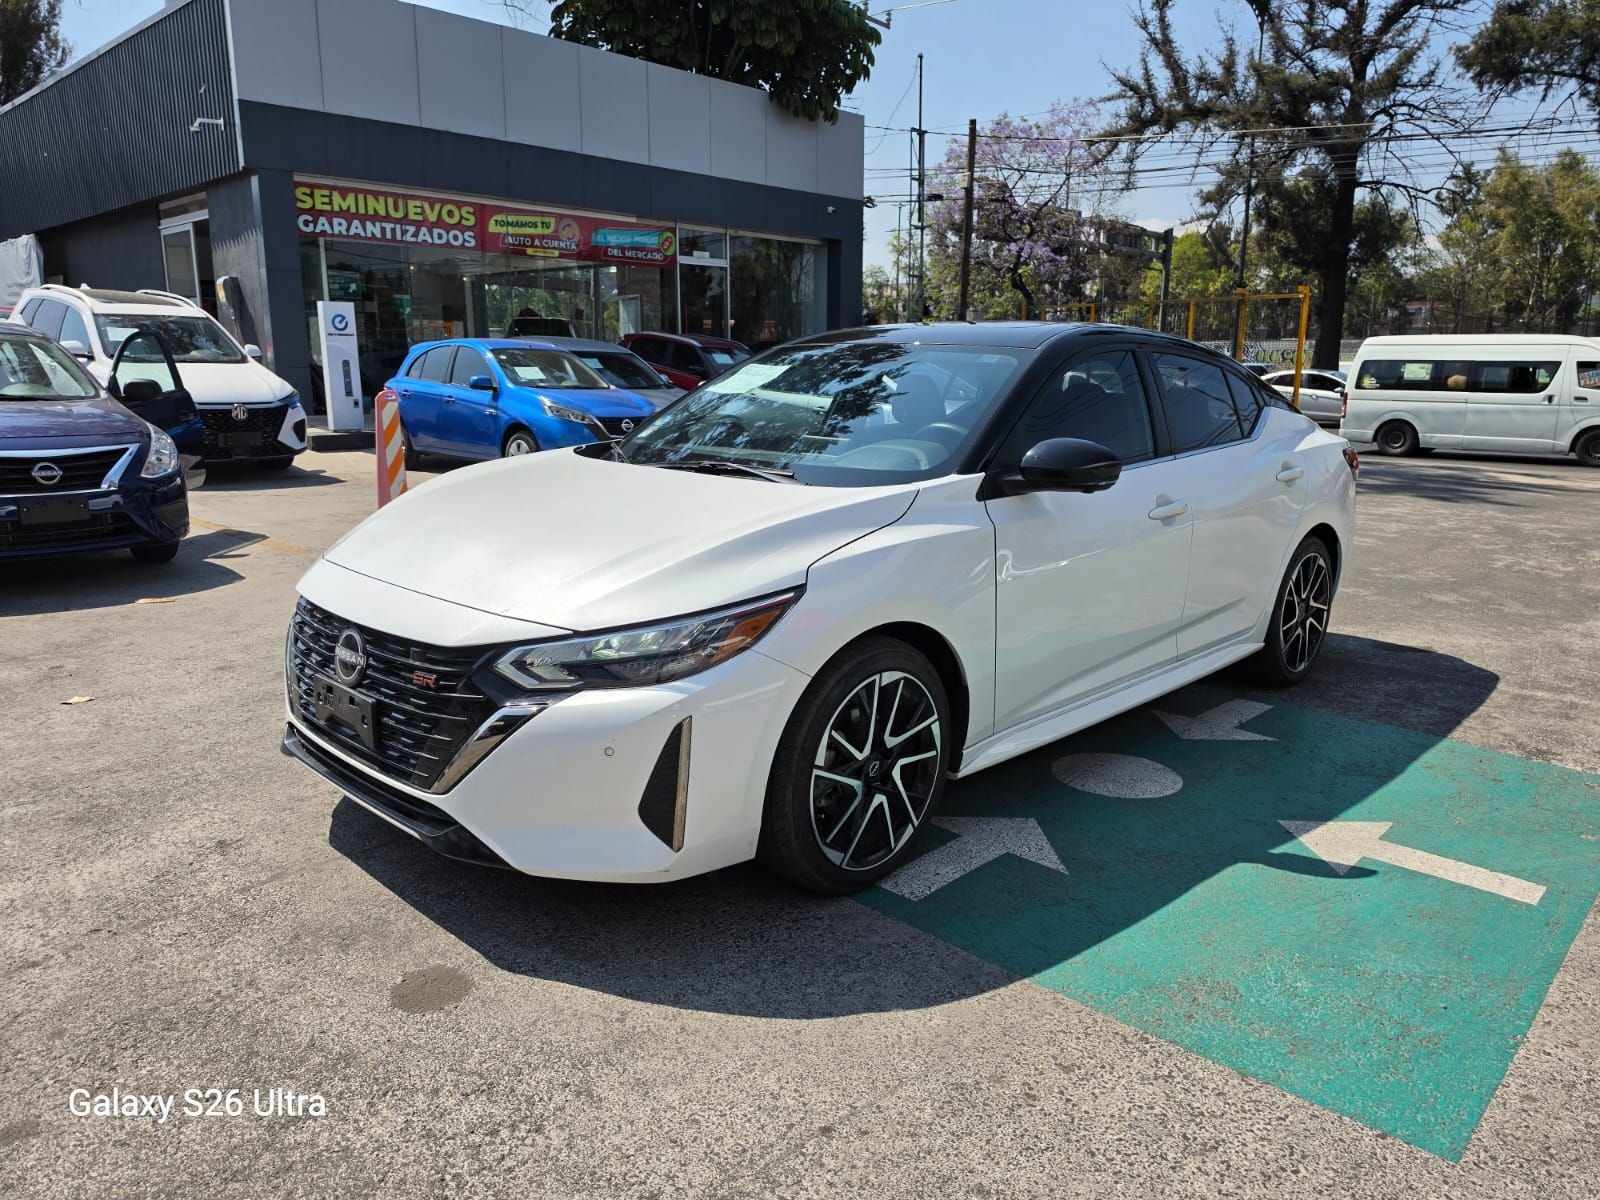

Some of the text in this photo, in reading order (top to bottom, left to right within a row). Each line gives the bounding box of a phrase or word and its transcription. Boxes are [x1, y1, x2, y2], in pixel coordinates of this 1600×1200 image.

[295, 187, 476, 226] SEMINUEVOS
[297, 214, 476, 247] GARANTIZADOS
[493, 219, 552, 229] TOMAMOS TU
[505, 235, 531, 246] AUTO
[543, 240, 577, 250] CUENTA
[607, 248, 664, 260] DEL MERCADO
[336, 645, 366, 667] NISSAN
